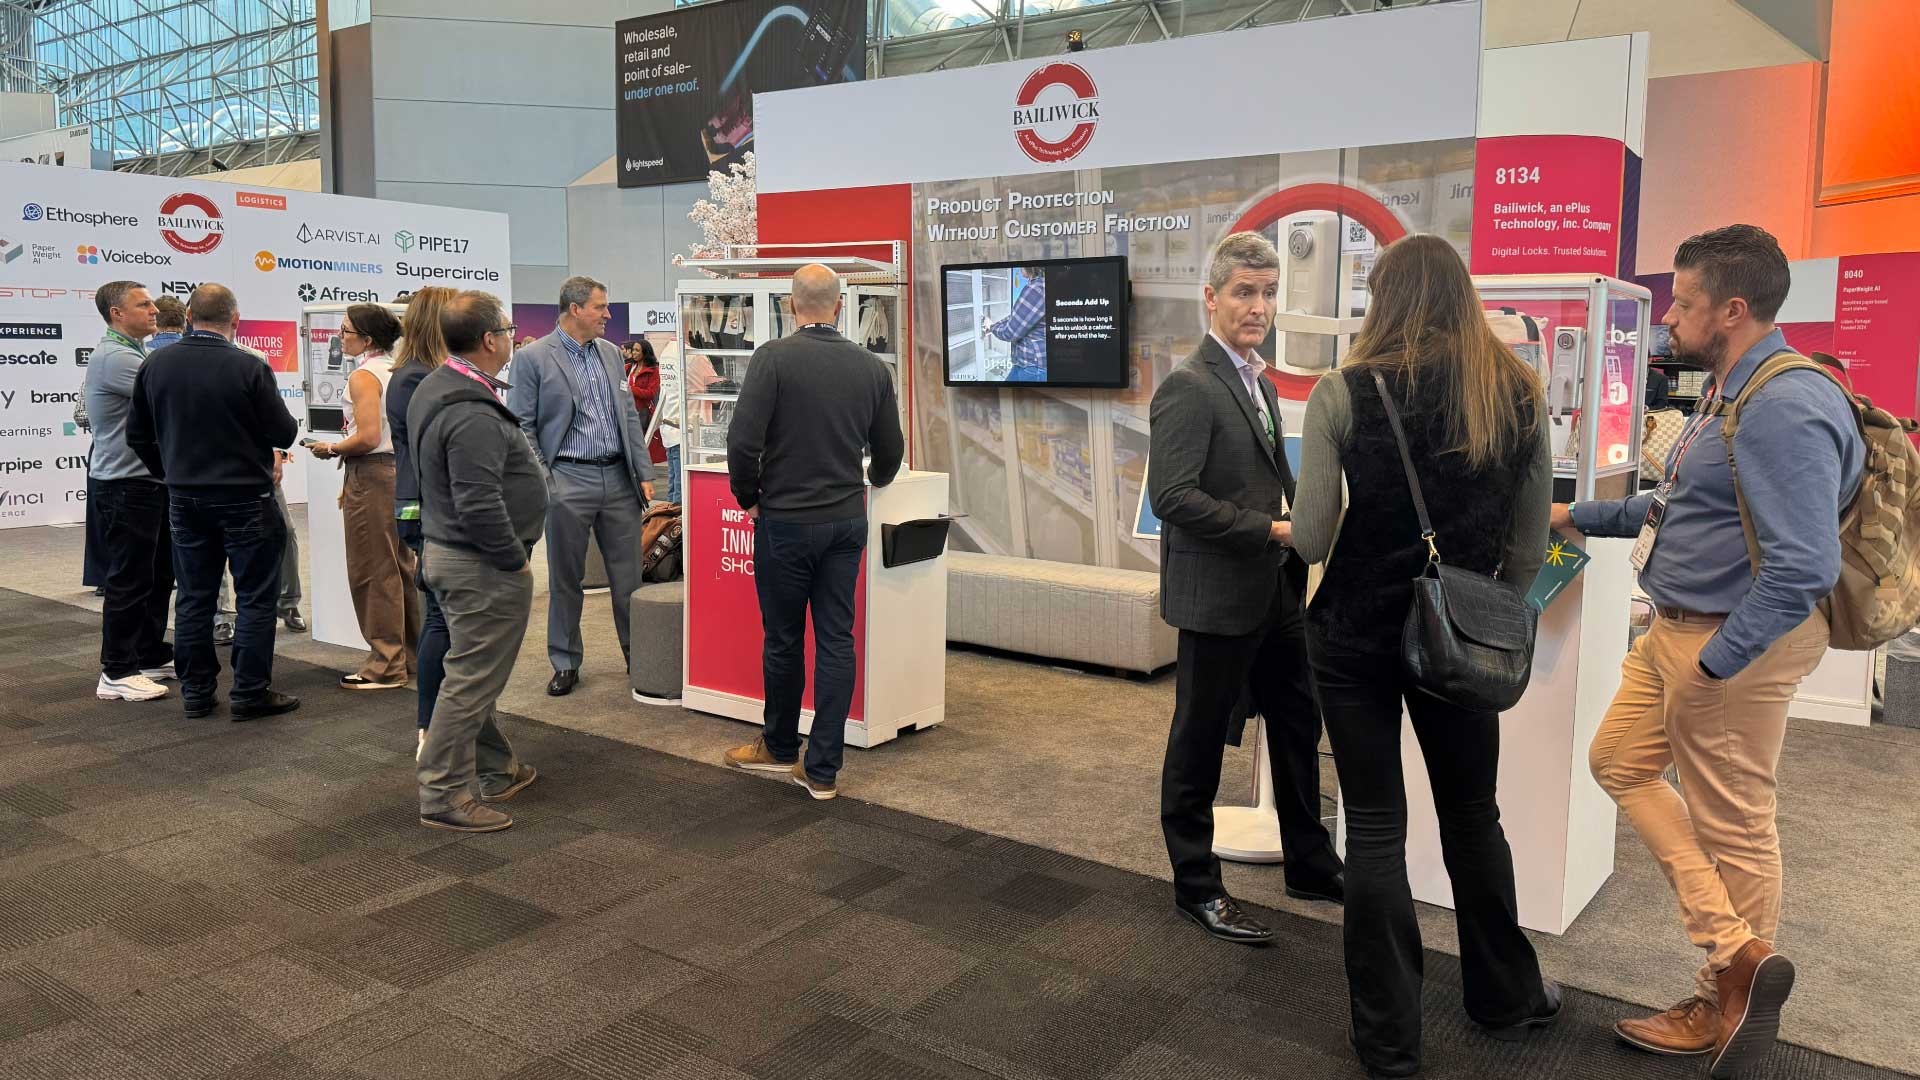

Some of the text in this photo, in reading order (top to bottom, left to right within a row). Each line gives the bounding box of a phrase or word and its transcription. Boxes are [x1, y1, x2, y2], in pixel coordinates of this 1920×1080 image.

[624, 24, 678, 45] Wholesale,
[624, 44, 670, 63] retail and
[624, 68, 649, 84] point
[651, 64, 662, 77] of
[624, 79, 699, 101] under one roof.
[1013, 101, 1100, 126] BAILIWICK
[632, 157, 664, 171] lightspeed
[1495, 166, 1541, 185] 8134
[239, 195, 283, 207] LOGISTICS
[927, 189, 1114, 215] PRODUCT PROTECTION
[1494, 202, 1590, 215] Bailiwick, an ePlus
[46, 207, 139, 227] Ethosphere
[158, 216, 224, 231] BAILIWICK
[928, 213, 1190, 242] WITHOUT CUSTOMER FRICTION
[1493, 218, 1559, 231] Technology,
[1583, 218, 1611, 234] Company
[314, 229, 380, 245] ARVIST.AI
[419, 235, 469, 254] PIPE17
[32, 244, 55, 252] Paper
[32, 251, 62, 260] Weight
[1492, 246, 1520, 258] Digital
[1522, 246, 1550, 256] Locks.
[1553, 246, 1581, 256] Trusted
[101, 248, 172, 266] Voicebox
[278, 257, 383, 274] MOTIONMINERS
[396, 261, 499, 282] Supercircle
[1844, 270, 1864, 279] 8040
[320, 286, 379, 302] Afresh
[1084, 298, 1098, 306] Add
[1099, 298, 1110, 307] Up
[1096, 315, 1108, 323] long
